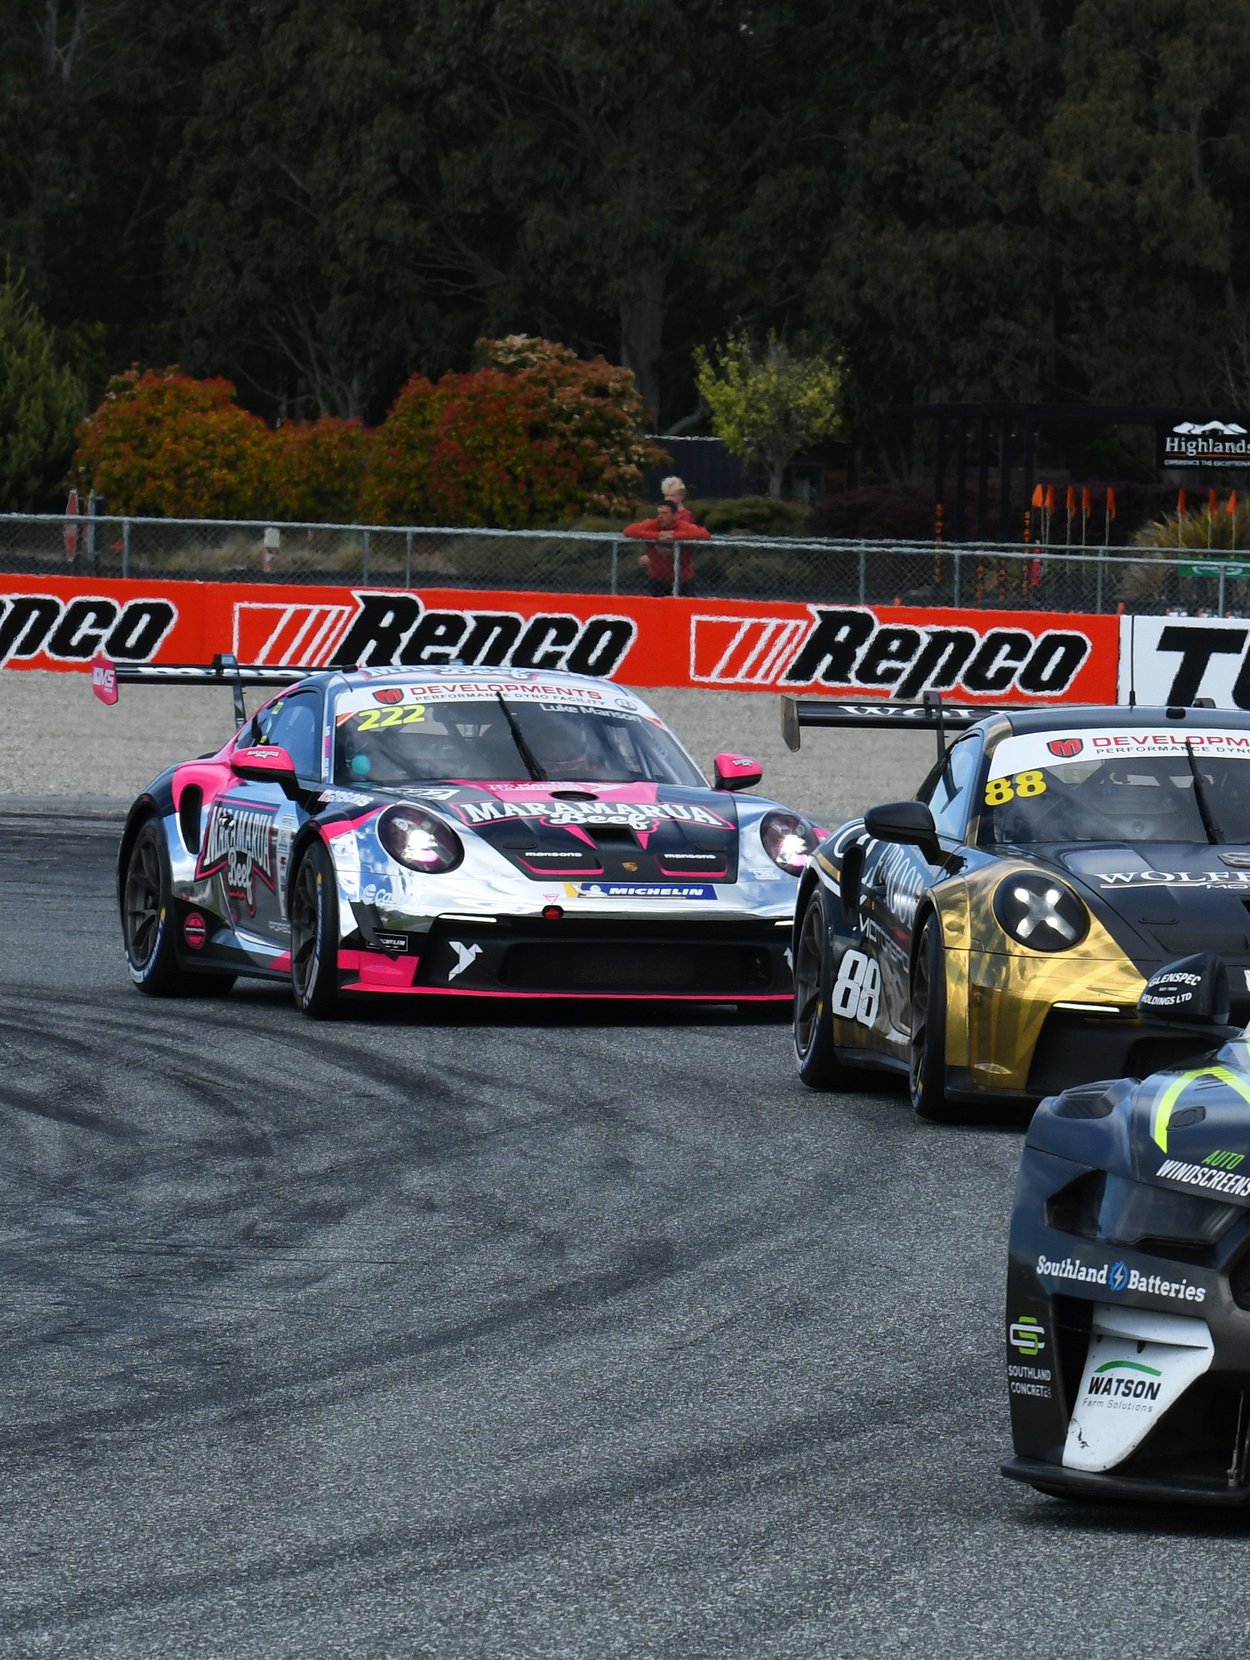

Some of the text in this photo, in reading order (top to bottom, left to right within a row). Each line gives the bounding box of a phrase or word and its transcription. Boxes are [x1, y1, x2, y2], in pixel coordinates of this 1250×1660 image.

[778, 604, 1092, 699] Repco
[410, 684, 602, 700] DEVELOPMENTS
[553, 695, 606, 706] FACILITY
[357, 704, 425, 731] 222
[540, 703, 642, 723] Luke Manson
[984, 769, 1047, 806] 88
[460, 801, 723, 828] MARAMARUA
[549, 812, 651, 831] Beef
[608, 886, 704, 897] MICHELIN
[831, 949, 881, 1030] 88
[1148, 972, 1202, 988] GLENSPEC
[1142, 992, 1193, 1006] HOLDINGS LTD
[1201, 1149, 1245, 1170] AUTO
[1036, 1254, 1206, 1302] Southland Batteries
[1008, 1364, 1051, 1382] SOUTHLAND
[1088, 1376, 1162, 1401] WATSON
[1082, 1397, 1153, 1413] Farm Solutions
